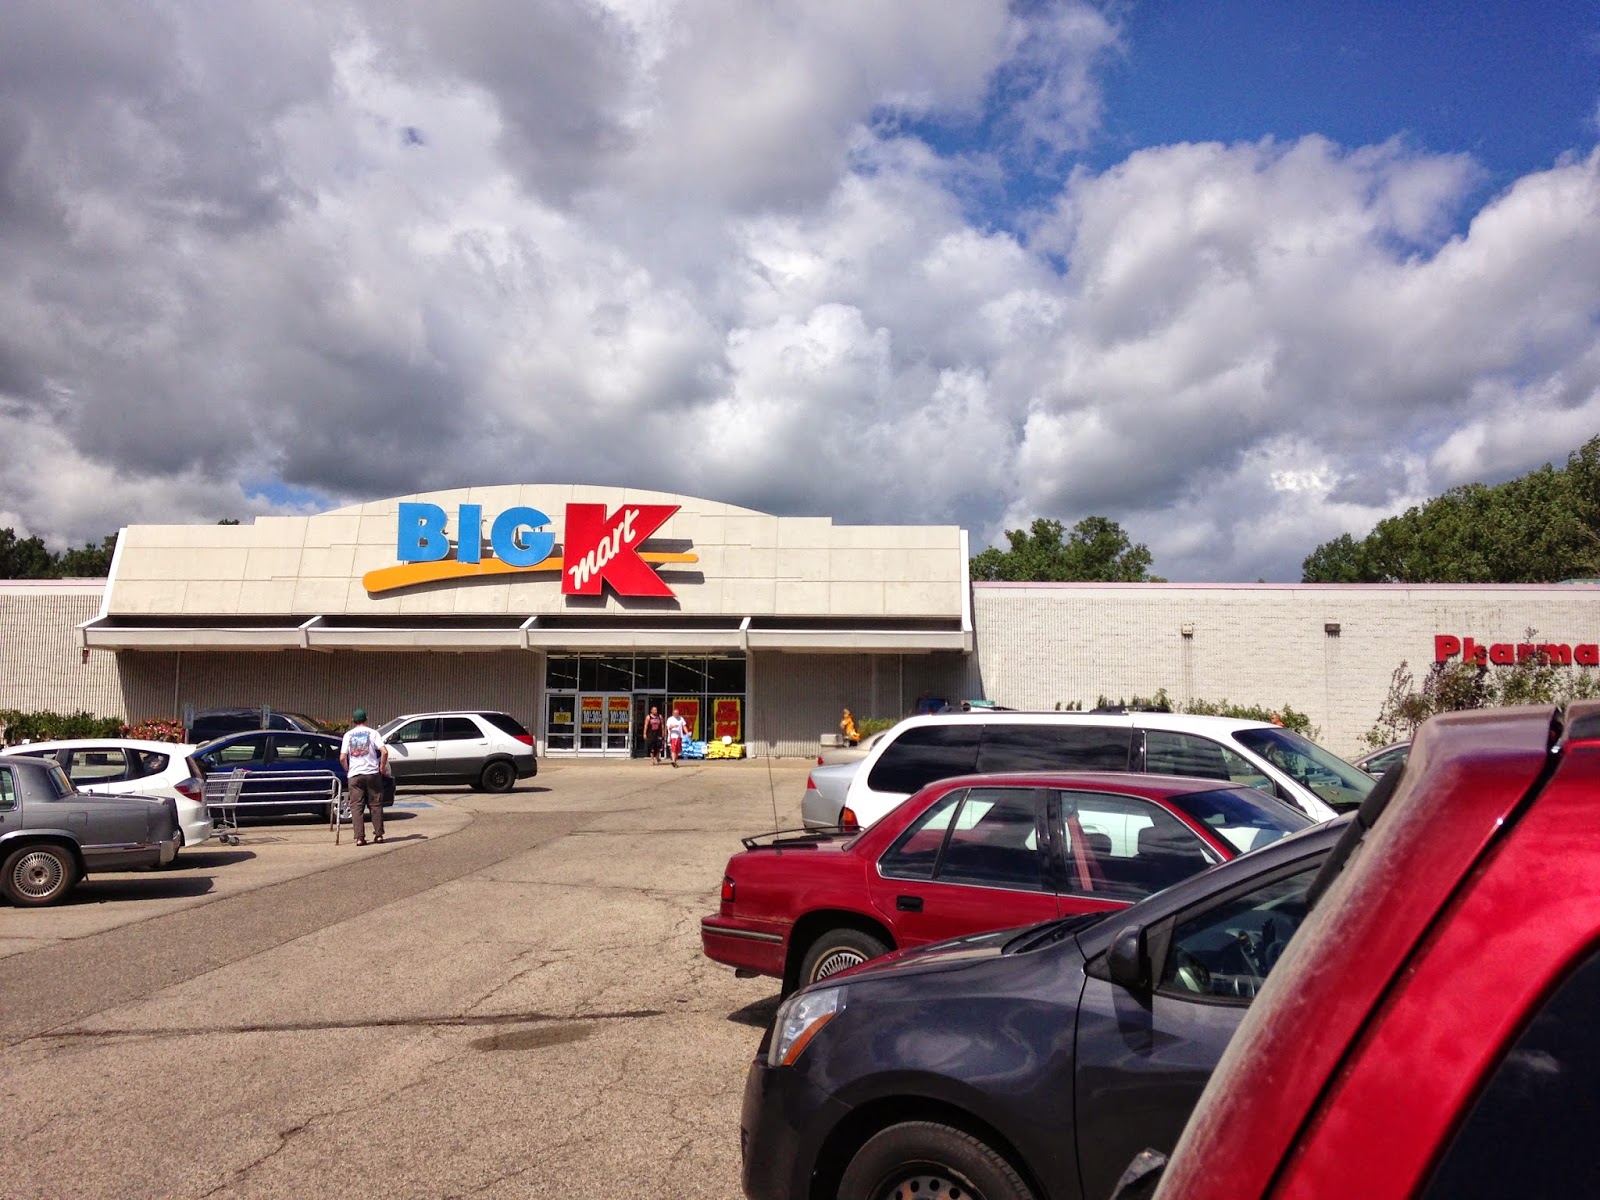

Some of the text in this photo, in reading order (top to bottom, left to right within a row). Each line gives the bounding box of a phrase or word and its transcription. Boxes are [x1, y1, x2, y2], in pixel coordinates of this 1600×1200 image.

[397, 502, 682, 597] BIG K
[568, 508, 640, 590] mart
